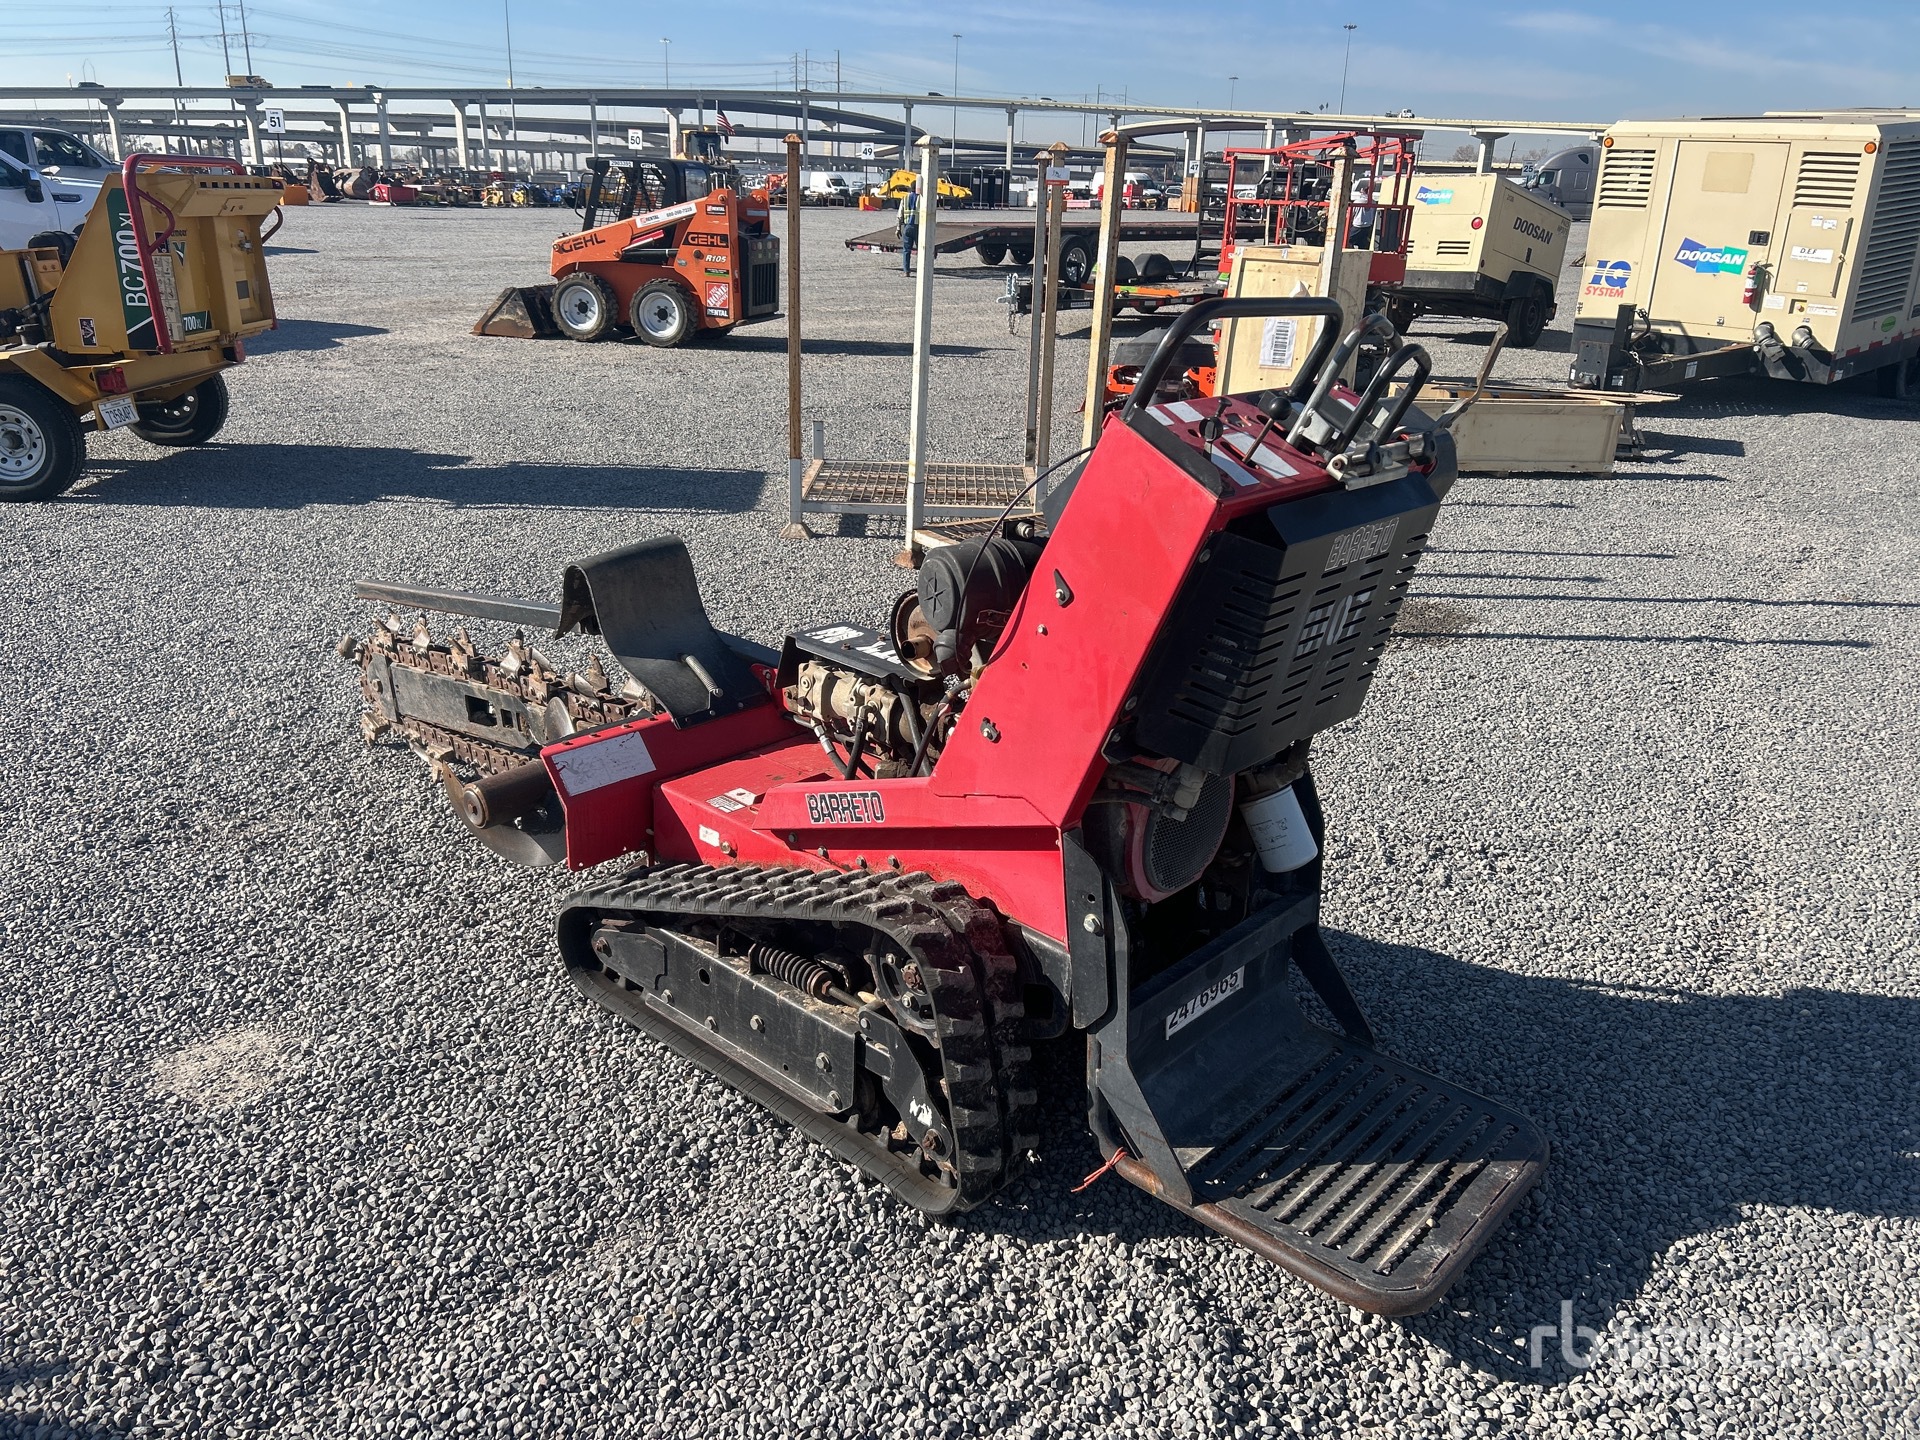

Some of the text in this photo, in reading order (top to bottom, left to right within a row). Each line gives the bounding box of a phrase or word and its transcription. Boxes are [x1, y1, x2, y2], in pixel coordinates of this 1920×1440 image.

[269, 116, 281, 128] 51
[629, 136, 641, 145] 50
[862, 147, 873, 156] 49
[1523, 165, 1534, 173] 25
[1416, 191, 1453, 201] DOOSAN
[1512, 216, 1554, 245] DOOSAN
[561, 233, 607, 254] GEHL
[688, 234, 728, 247] GEHL
[706, 254, 728, 263] R105
[1676, 249, 1745, 270] DOOSAN
[1588, 260, 1632, 289] IQ
[707, 284, 729, 307] HOME
[1584, 286, 1625, 298] SYSTEM
[1324, 517, 1400, 571] BARRETO
[806, 792, 885, 824] BARRETO
